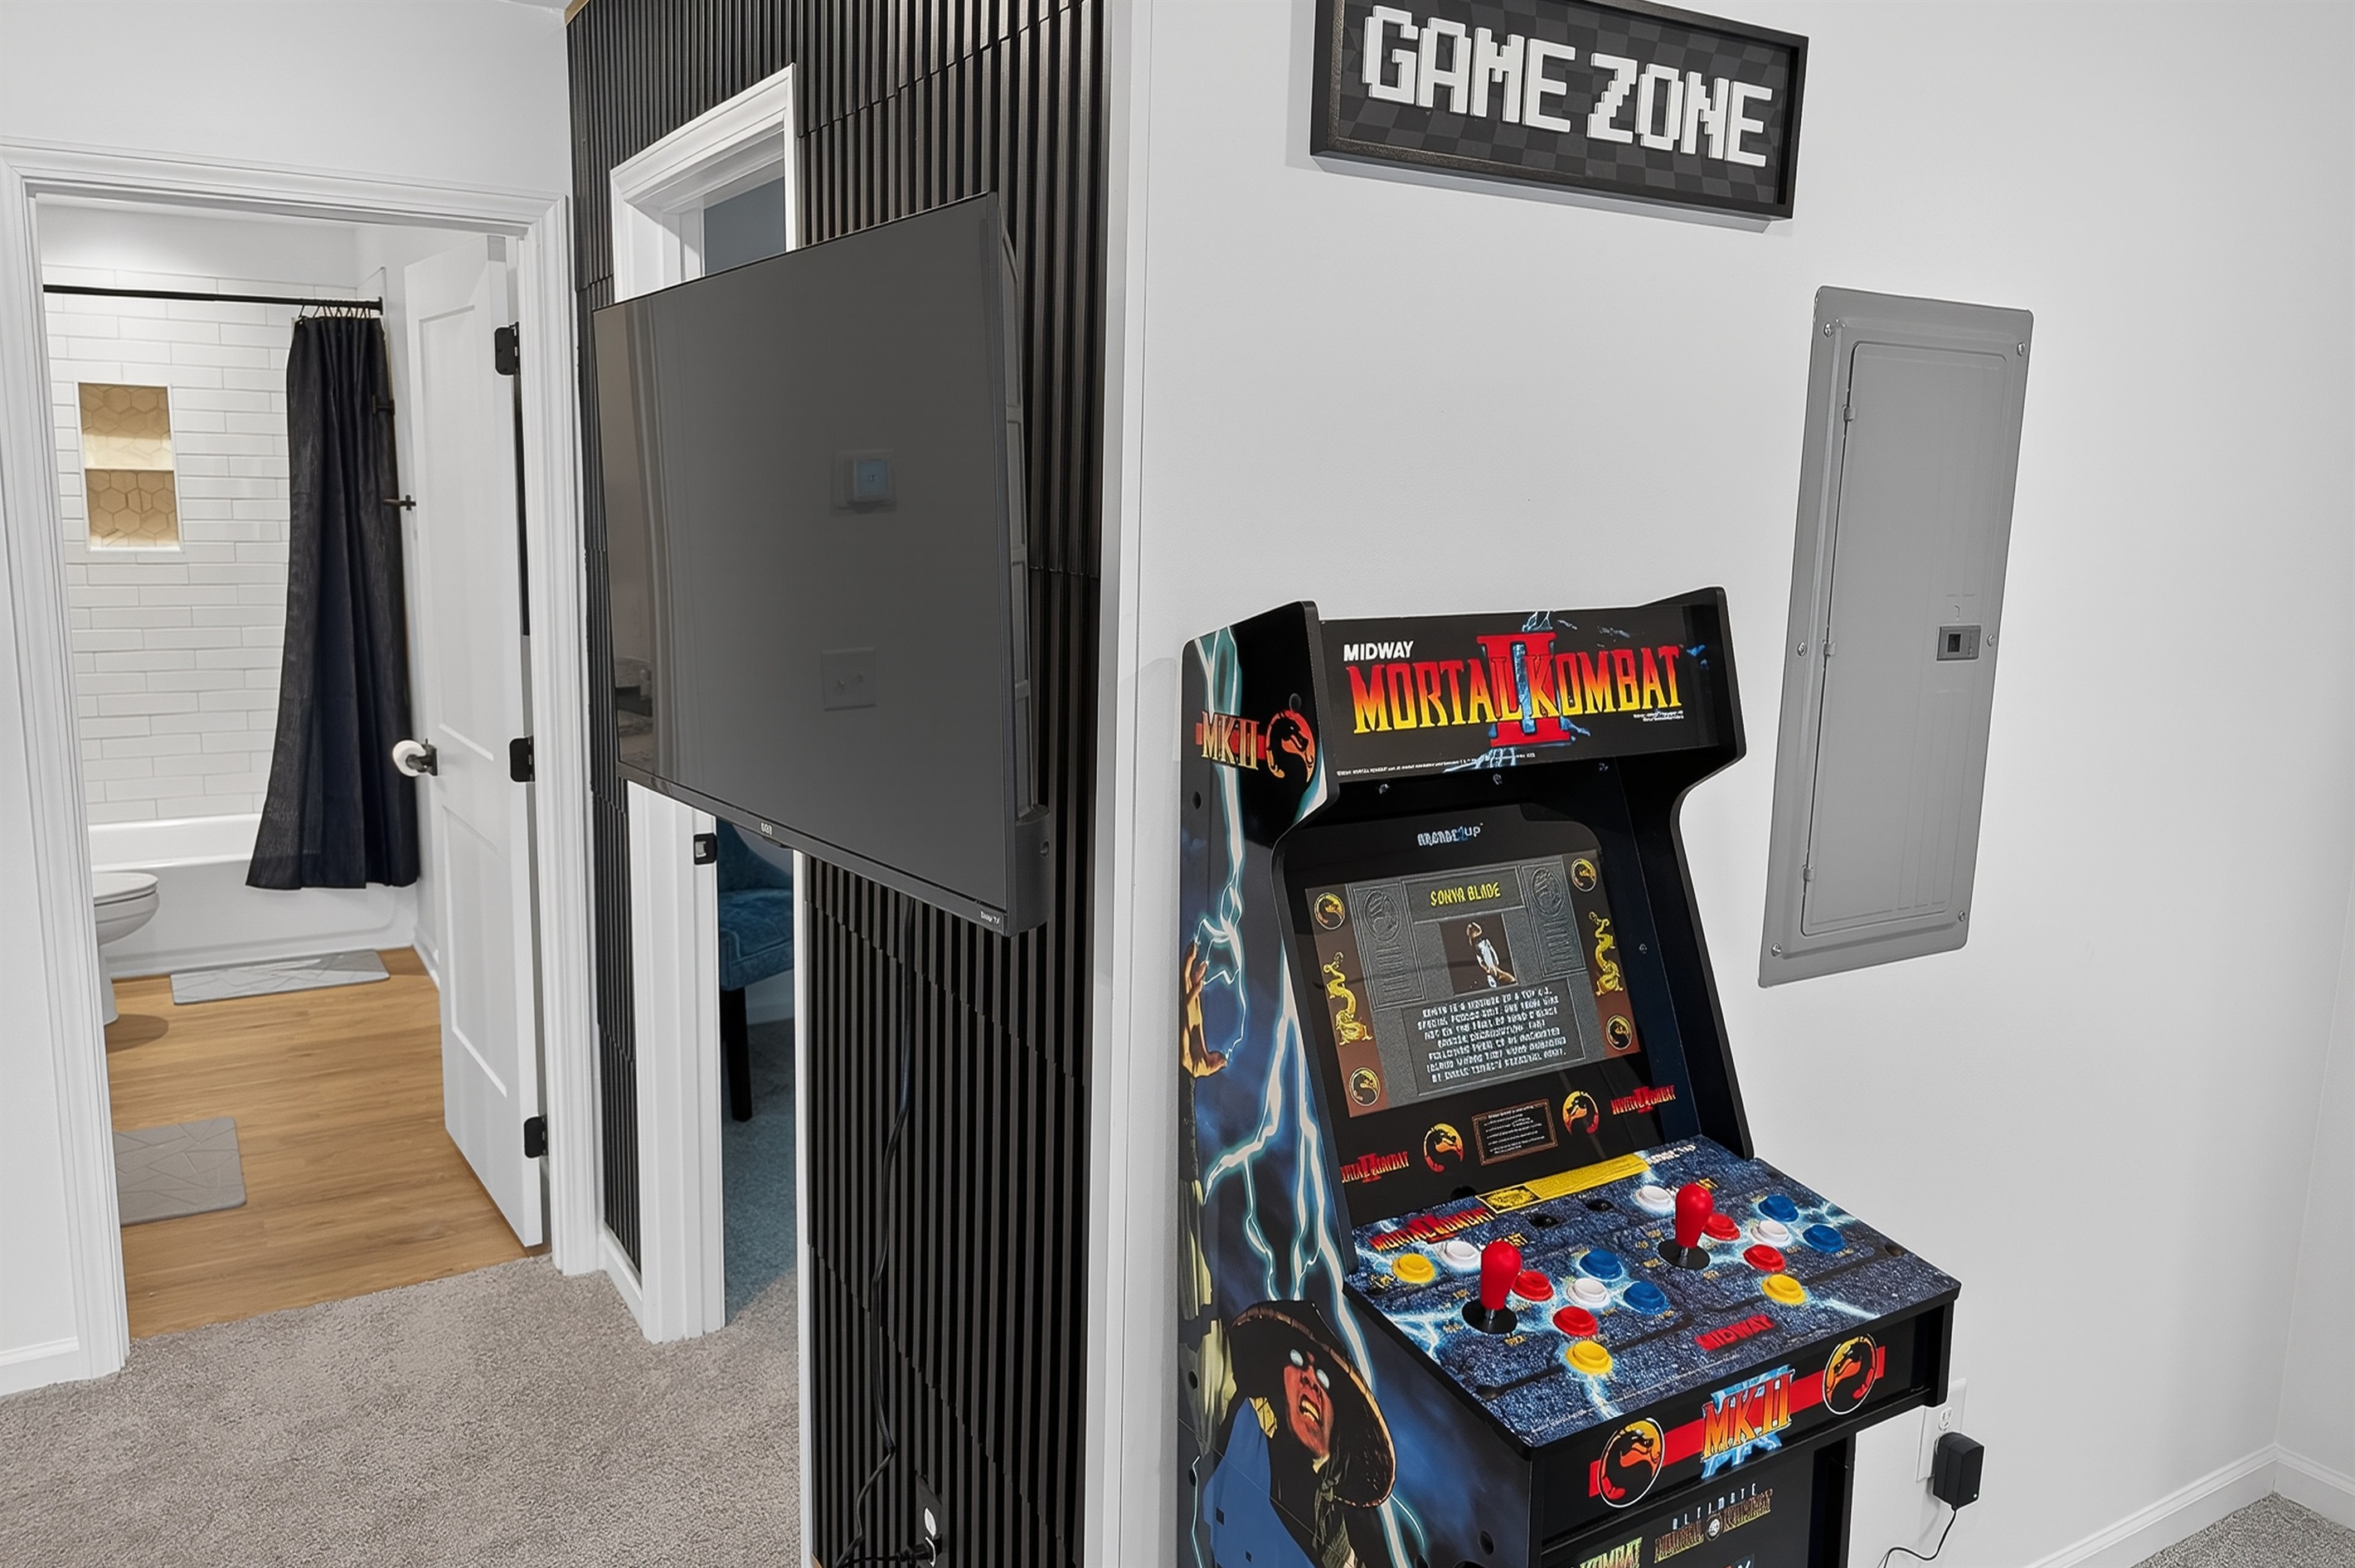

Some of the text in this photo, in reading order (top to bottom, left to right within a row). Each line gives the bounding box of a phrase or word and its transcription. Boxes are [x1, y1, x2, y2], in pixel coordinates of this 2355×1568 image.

[1362, 5, 1773, 167] GAME ZONE
[1343, 641, 1413, 662] MIDWAY
[1346, 645, 1682, 734] MORTAL KOMBAT
[1430, 881, 1500, 906] SONYA BLADE
